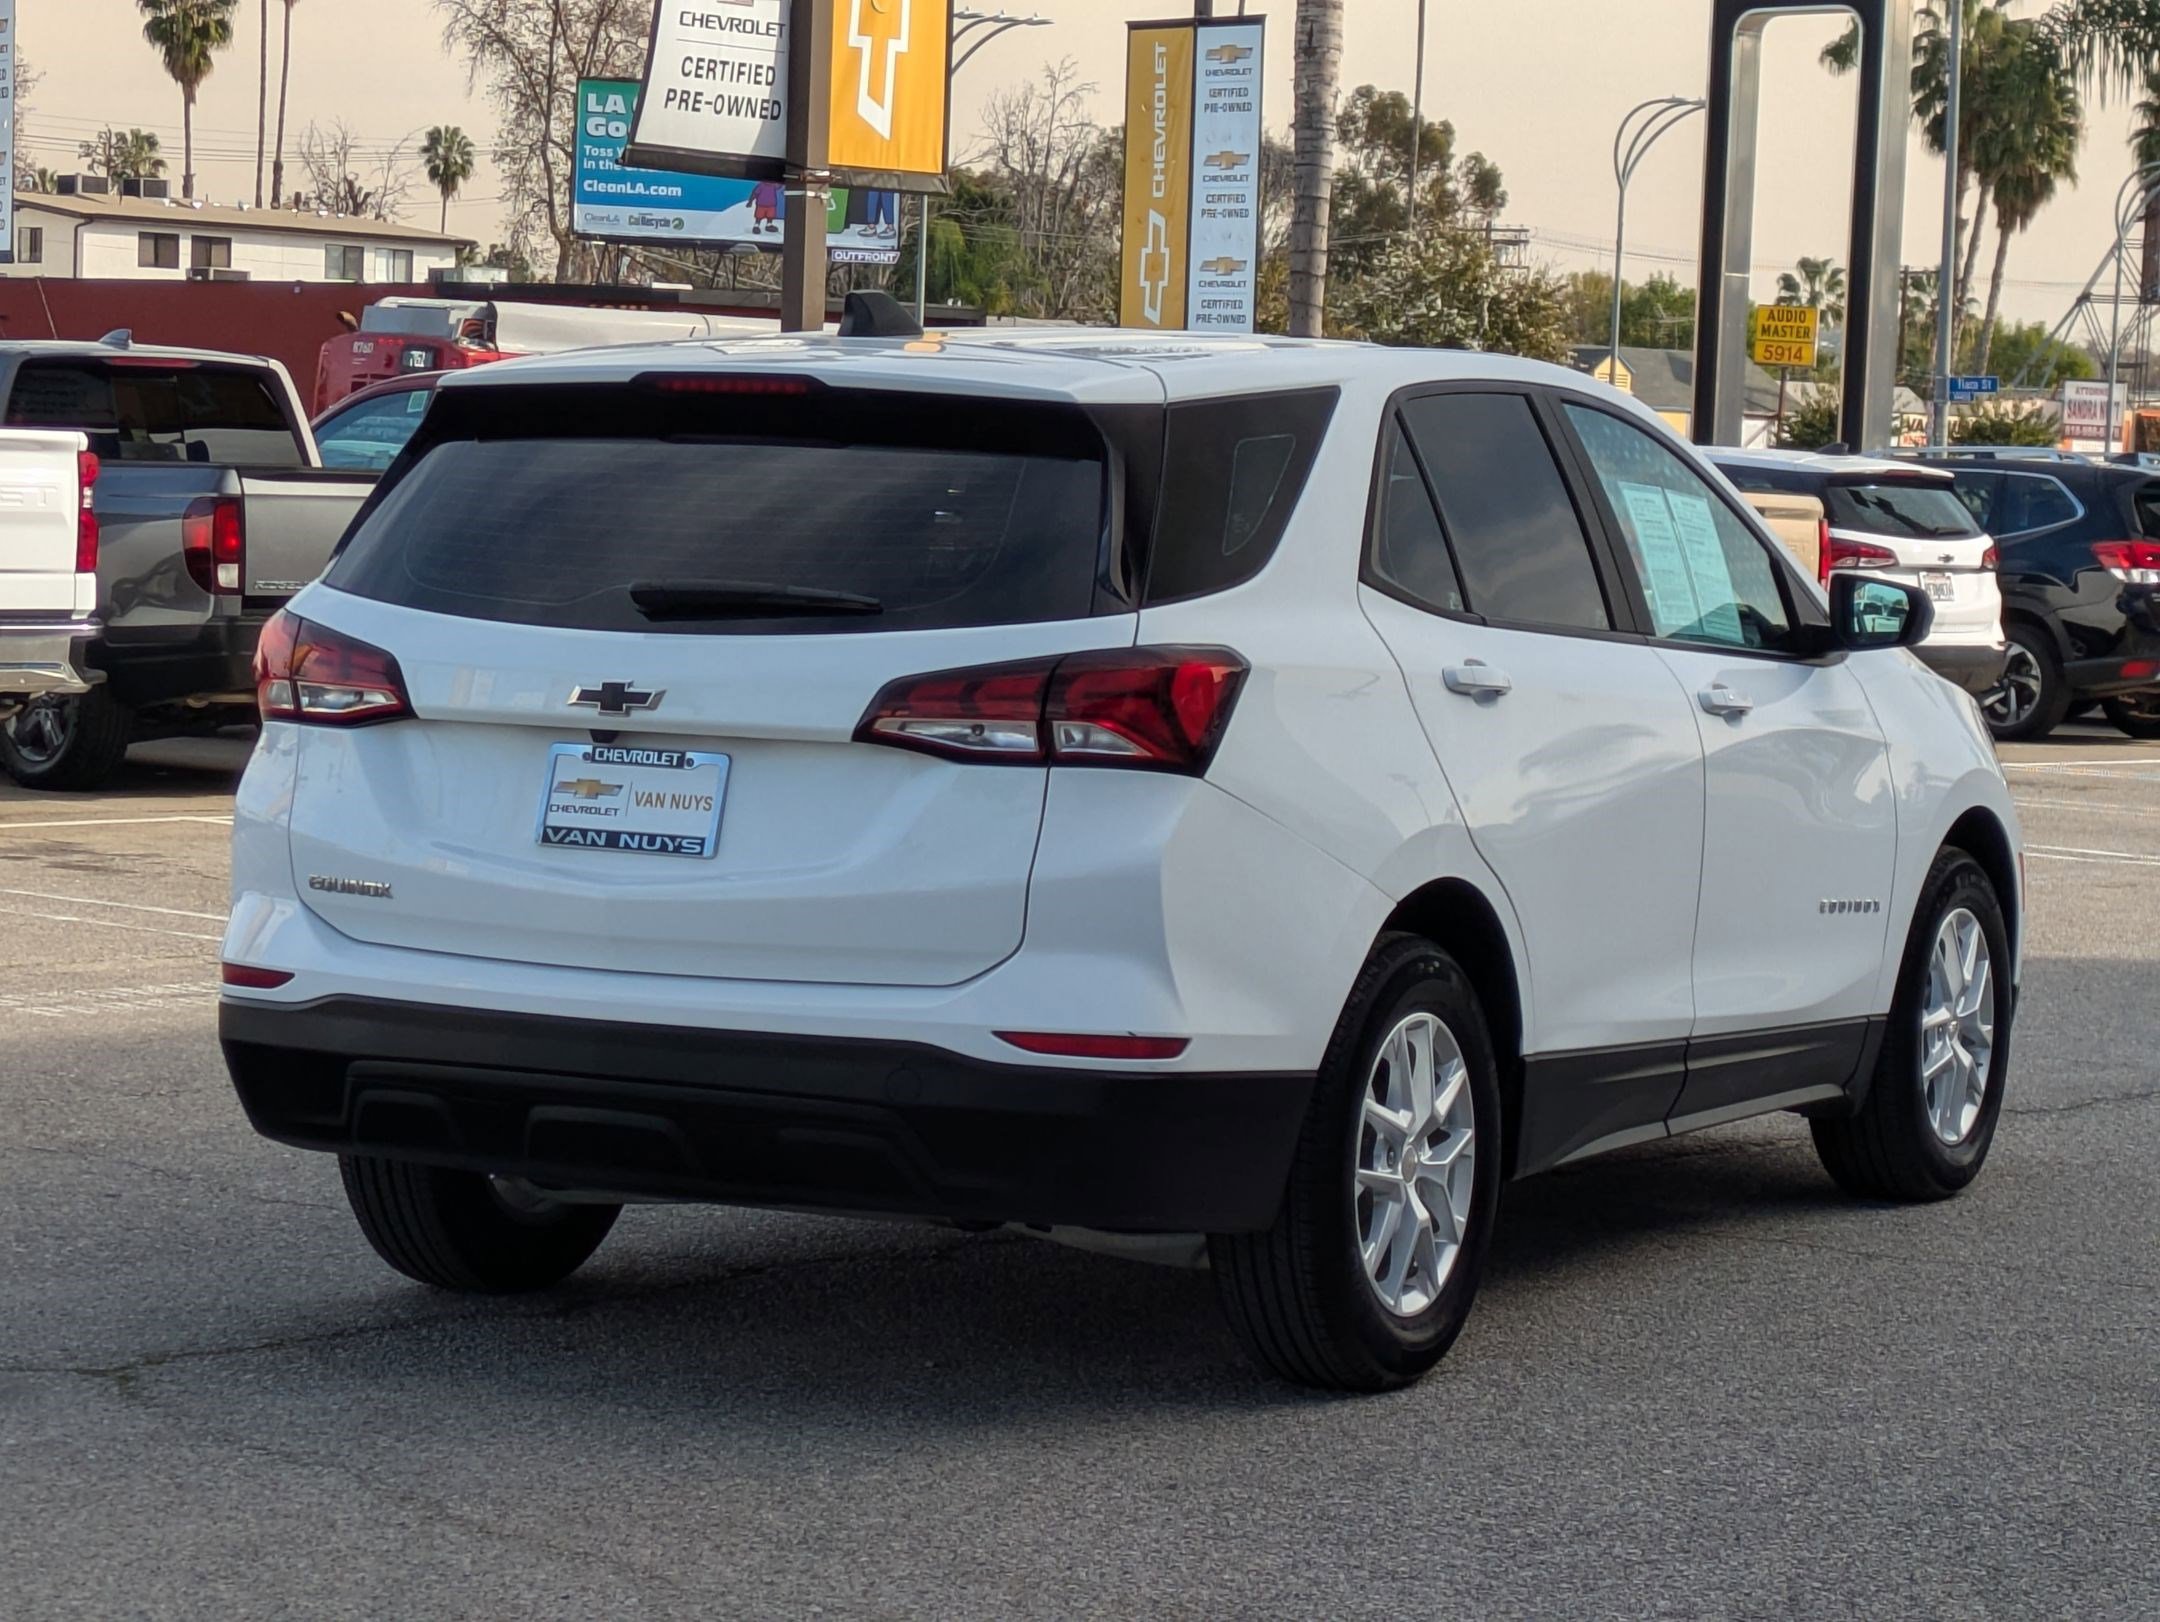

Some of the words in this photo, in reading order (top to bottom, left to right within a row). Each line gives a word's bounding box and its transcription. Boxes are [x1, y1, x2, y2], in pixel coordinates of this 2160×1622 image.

[679, 11, 786, 38] CHEVROLET
[681, 56, 776, 86] CERTIFIED
[1205, 68, 1252, 77] CHEVROLET
[1209, 87, 1249, 98] CERTIFIED
[664, 87, 781, 120] PRE-OWNED
[1204, 102, 1252, 113] PRE-OWNED
[1152, 41, 1168, 198] CHEVROLET
[584, 145, 614, 157] Toss
[1203, 174, 1250, 183] CHEVROLET
[583, 179, 682, 197] CleanLA.com
[1205, 194, 1246, 204] CERTIFIED
[1201, 208, 1249, 218] PRE-OWNED
[834, 251, 897, 262] OUTFRONT
[1198, 280, 1247, 288] CHEVROLET
[1200, 299, 1243, 309] CERTIFIED
[1195, 314, 1247, 324] PRE-OWNED
[1767, 309, 1807, 324] AUDIO
[1761, 324, 1811, 339] MASTER
[1763, 344, 1804, 362] 5914
[594, 748, 681, 767] CHEVROLET
[635, 791, 665, 809] VAN
[670, 794, 713, 812] NUYS
[549, 804, 620, 817] CHEVROLET
[546, 828, 606, 846] VAN
[618, 834, 702, 854] NUYS
